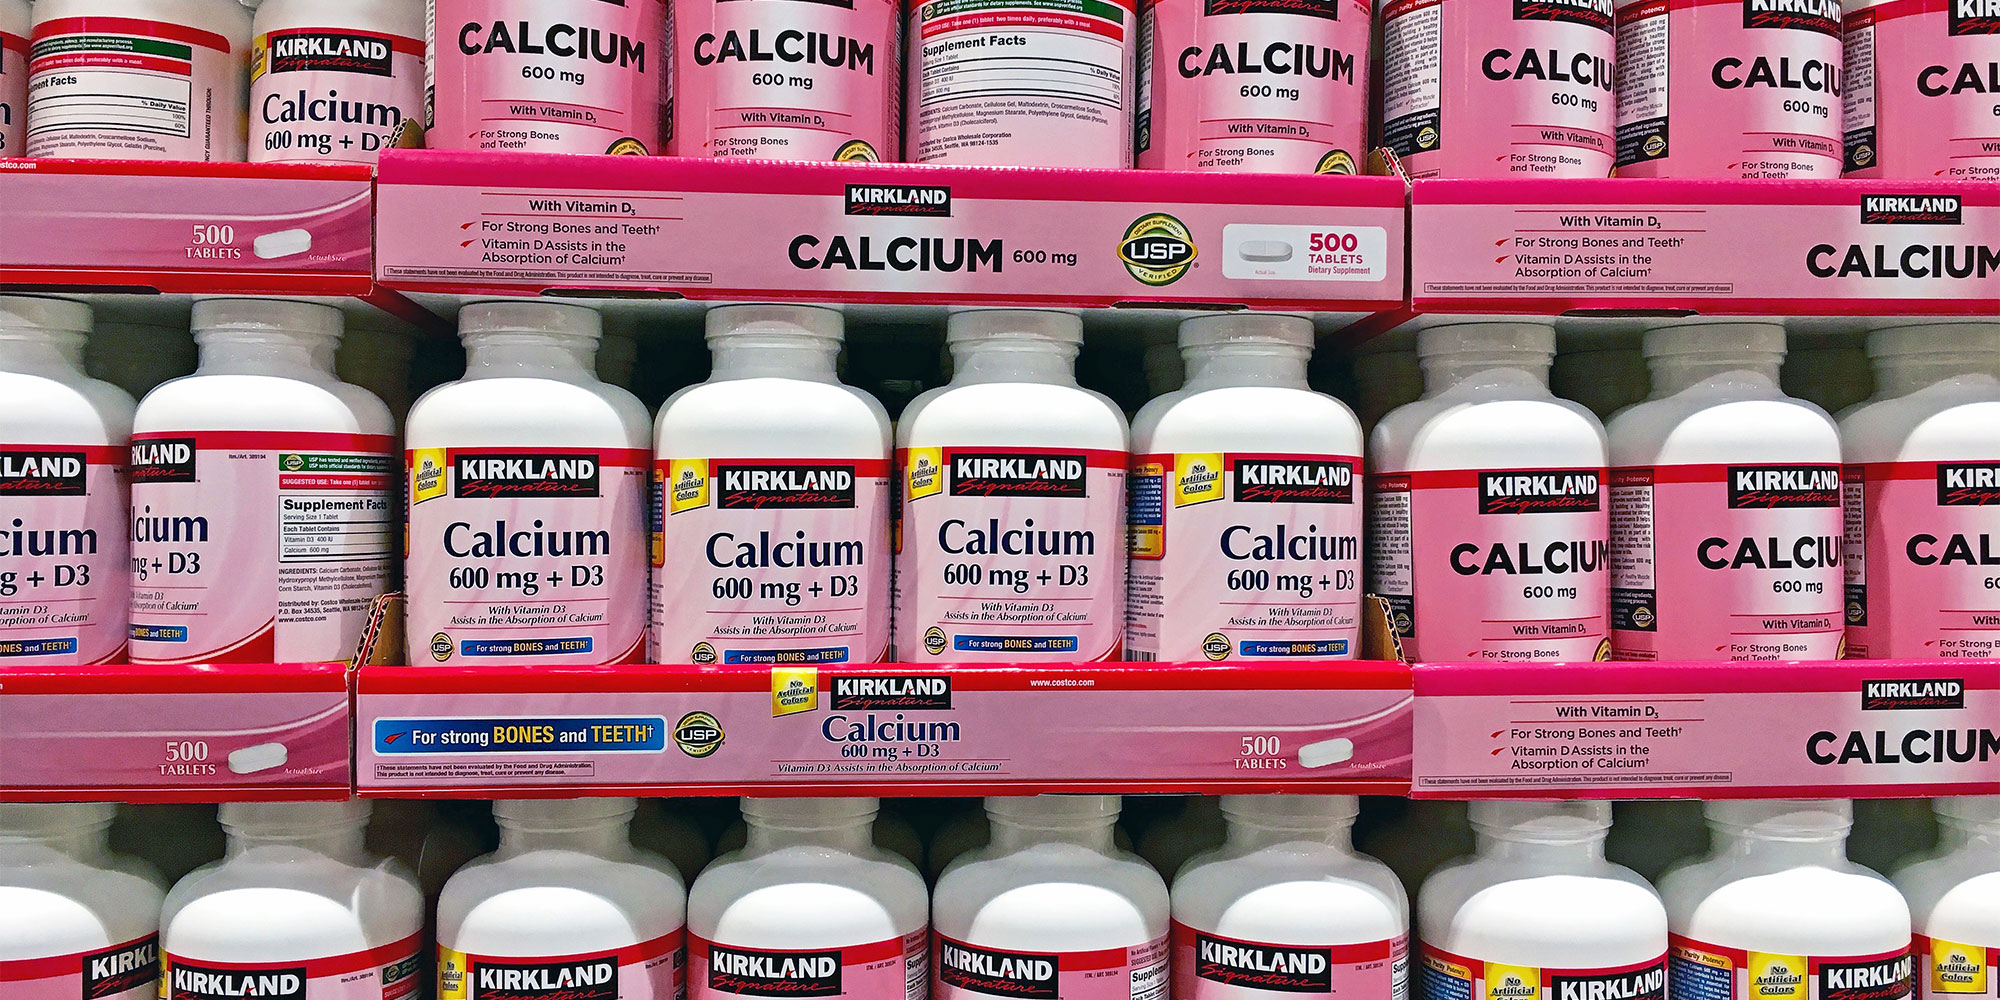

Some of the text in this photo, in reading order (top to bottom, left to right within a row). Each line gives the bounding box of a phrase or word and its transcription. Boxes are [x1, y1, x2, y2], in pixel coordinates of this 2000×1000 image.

[275, 37, 387, 60] KIRKLAND
[459, 21, 645, 74] CALCIUM
[694, 29, 873, 75] CALCIUM
[923, 35, 1026, 58] Supplement Facts
[1178, 42, 1354, 85] CALCIUM
[1482, 49, 1615, 95] CALCIU
[51, 75, 77, 86] Facts
[522, 66, 584, 85] 600 mg
[752, 74, 813, 89] 600 mg
[1240, 86, 1299, 100] 600 mg
[150, 101, 186, 111] Daily Value
[263, 91, 401, 127] Calcium
[1552, 93, 1597, 112] 600 mg
[1783, 100, 1828, 118] 600 mg
[510, 106, 536, 115] With
[540, 107, 582, 120] Vitamin
[265, 131, 331, 154] 600 mg
[497, 131, 527, 140] Strong
[530, 131, 559, 141] Bones
[1742, 162, 1814, 171] For Strong Bones
[851, 188, 946, 204] KIRKLAND
[529, 200, 561, 212] With
[566, 200, 617, 213] Vitamin
[851, 202, 946, 216] Signature
[1866, 198, 1958, 214] KIRKLAND
[482, 221, 503, 232] For
[507, 222, 549, 234] Strong
[553, 223, 591, 234] Bones
[595, 224, 617, 235] and
[1560, 216, 1591, 227] With
[1594, 216, 1644, 227] Vitamin
[192, 224, 234, 245] 500
[1309, 233, 1357, 252] 500
[185, 248, 241, 259] TABLETS
[482, 239, 625, 252] Vitamin D Assists in the
[788, 234, 1002, 272] CALCIUM
[1130, 243, 1186, 259] USP
[482, 253, 552, 264] Absorption
[555, 254, 568, 264] of
[1013, 250, 1077, 266] 600 mg
[1308, 254, 1363, 263] TABLETS
[1308, 266, 1370, 275] Dietary Supplement
[461, 459, 595, 480] KIRKLAND
[957, 458, 1082, 480] KIRKLAND
[1179, 471, 1218, 485] Artificial
[1242, 465, 1351, 486] KIRKLAND
[461, 478, 594, 496] Signature
[725, 469, 851, 491] KIRKLAND
[1487, 475, 1597, 496] KIRKLAND
[1737, 471, 1838, 490] KIRKLAND
[284, 499, 387, 512] Supplement Facts
[443, 520, 610, 559] Calcium
[938, 518, 1094, 557] Calcium
[1220, 524, 1356, 562] Calcium
[706, 531, 863, 568] Calcium
[449, 565, 604, 596] 600 mg D3
[1227, 569, 1313, 598] 600 mg
[712, 577, 800, 606] 600 mg
[1524, 586, 1577, 599] 600 mg
[488, 605, 566, 615] With Vitamin D3
[489, 644, 511, 653] strong
[514, 643, 543, 651] BONES
[545, 643, 558, 651] and
[838, 679, 946, 696] KIRKLAND
[1868, 682, 1960, 697] KIRKLAND
[838, 696, 946, 711] Signature
[412, 730, 437, 745] For
[441, 729, 489, 747] strong
[494, 725, 554, 744] BONES
[560, 728, 587, 743] and
[681, 729, 716, 740] USP
[822, 714, 960, 742] Calcium
[1535, 728, 1575, 740] Strong
[1579, 728, 1615, 738] Bones
[165, 741, 209, 762] 500
[841, 744, 939, 761] 600 mg D3
[1240, 736, 1280, 756] 500
[1806, 729, 2000, 765] CALCIUM
[158, 764, 217, 776] TABLETS
[778, 763, 946, 774] Vitamin Assists Absorption
[1234, 758, 1286, 769] TABLETS
[714, 951, 836, 980] KIRKLAND
[943, 943, 1054, 981] KIRKLAND
[1200, 940, 1327, 975] KIRKLAND
[1936, 963, 1980, 972] Artificial
[174, 968, 300, 996] KIRKLAND
[479, 963, 611, 992] KIRKLAND
[1506, 977, 1520, 986] No
[1561, 969, 1662, 1000] KIRKLAND
[1755, 974, 1802, 985] Artificial
[1760, 984, 1795, 994] Colors
